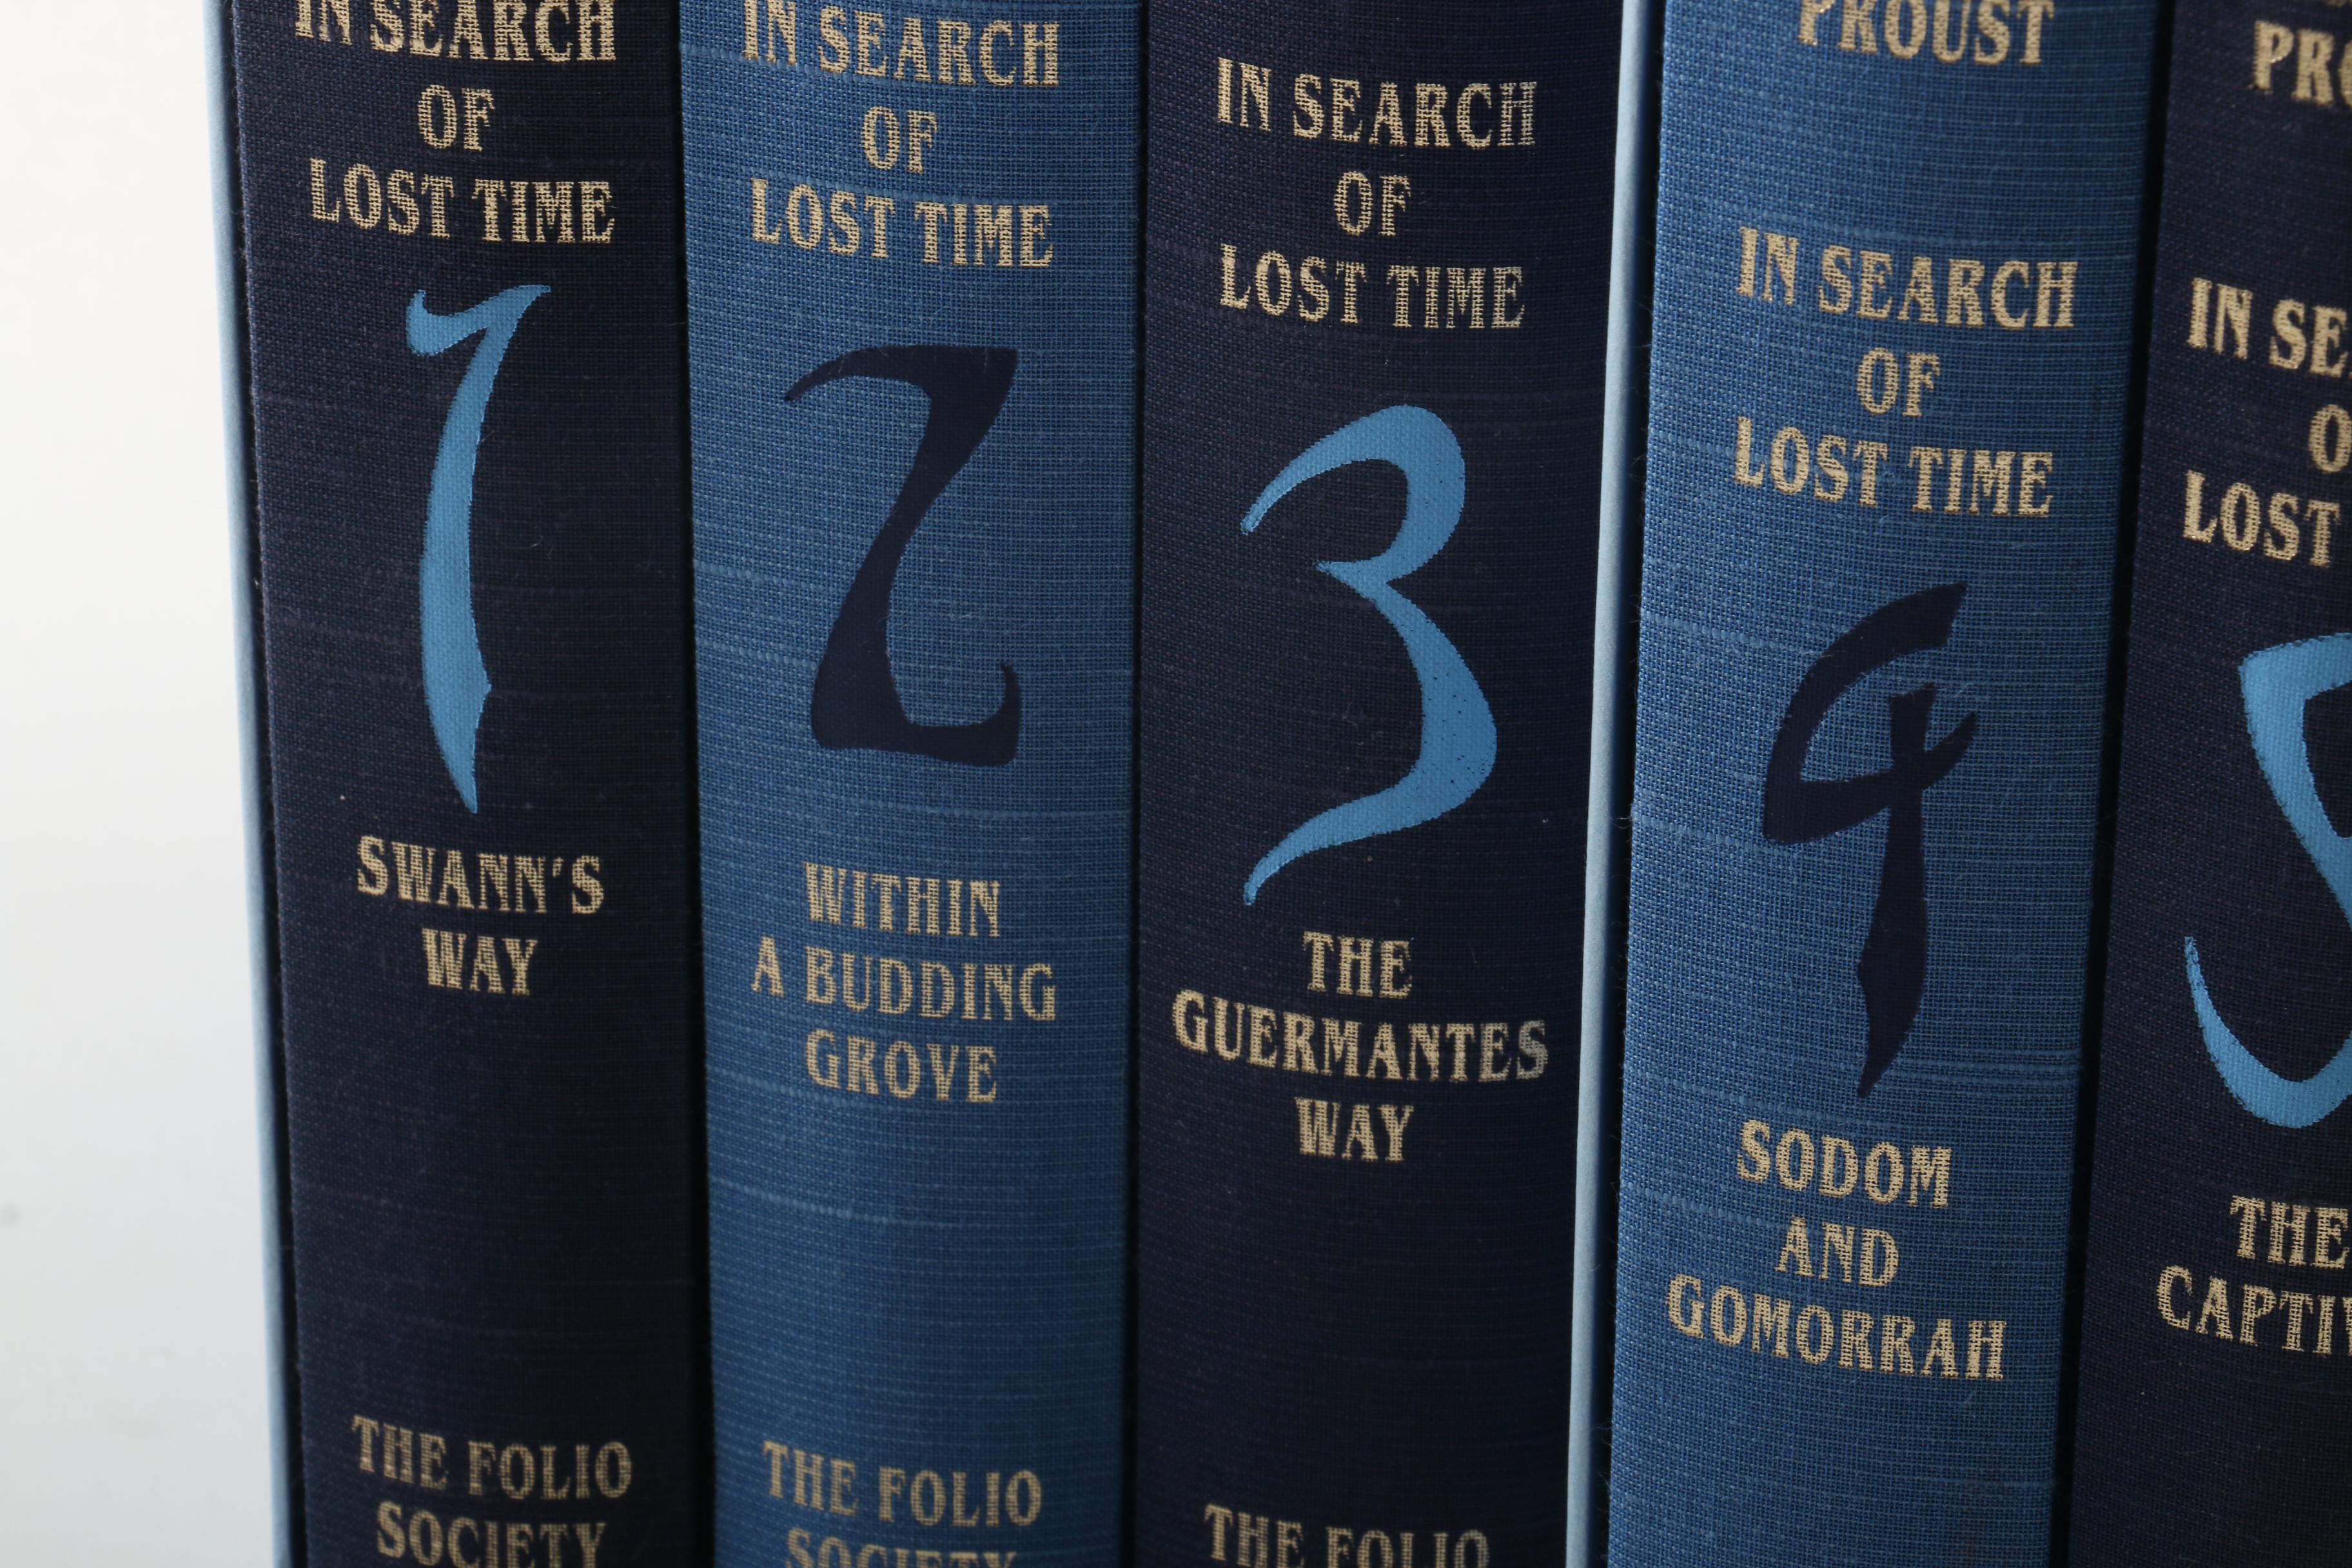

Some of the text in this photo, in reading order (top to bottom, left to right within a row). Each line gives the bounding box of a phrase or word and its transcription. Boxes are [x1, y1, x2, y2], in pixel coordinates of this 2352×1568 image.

[369, 0, 617, 63] SEARCH
[743, 0, 1060, 86] IN SEARCH
[1798, 0, 2054, 64] PROUST
[417, 84, 496, 152] OF
[861, 105, 938, 173] OF
[1217, 57, 1538, 149] IN SEARCH
[309, 158, 616, 244] LOST TIME
[750, 178, 1054, 268] LOST TIME
[1333, 170, 1412, 237] OF
[1219, 242, 1525, 329] LOST TIME
[1736, 226, 2079, 329] IN SEARCH
[2187, 277, 2352, 378] IN SE
[1857, 346, 1941, 417] OF
[1732, 416, 2054, 517] LOST TIME
[406, 284, 552, 813] 1
[784, 344, 1023, 767] 2
[2182, 469, 2342, 568] LOST
[1240, 404, 1498, 905] 3
[357, 836, 604, 914] SWANN'S
[1763, 582, 1977, 1097] 4
[803, 861, 1001, 937] WITHIN
[421, 928, 538, 995] WAY
[751, 936, 1056, 1021] A BUDDING
[1302, 930, 1412, 999] THE
[805, 1028, 998, 1103] GROVE
[1171, 989, 1549, 1083] GUERMANTES
[1294, 1097, 1415, 1162] WAY
[1736, 1119, 1953, 1208] SODOM
[1774, 1216, 1901, 1288] AND
[2230, 1195, 2350, 1269] THE
[1666, 1273, 2008, 1381] GOMORRAH
[351, 1415, 632, 1500] THE FOLIO
[763, 1440, 1043, 1527] THE FOLIO
[377, 1500, 607, 1568] SOCIETY
[1204, 1504, 1304, 1568] THE
